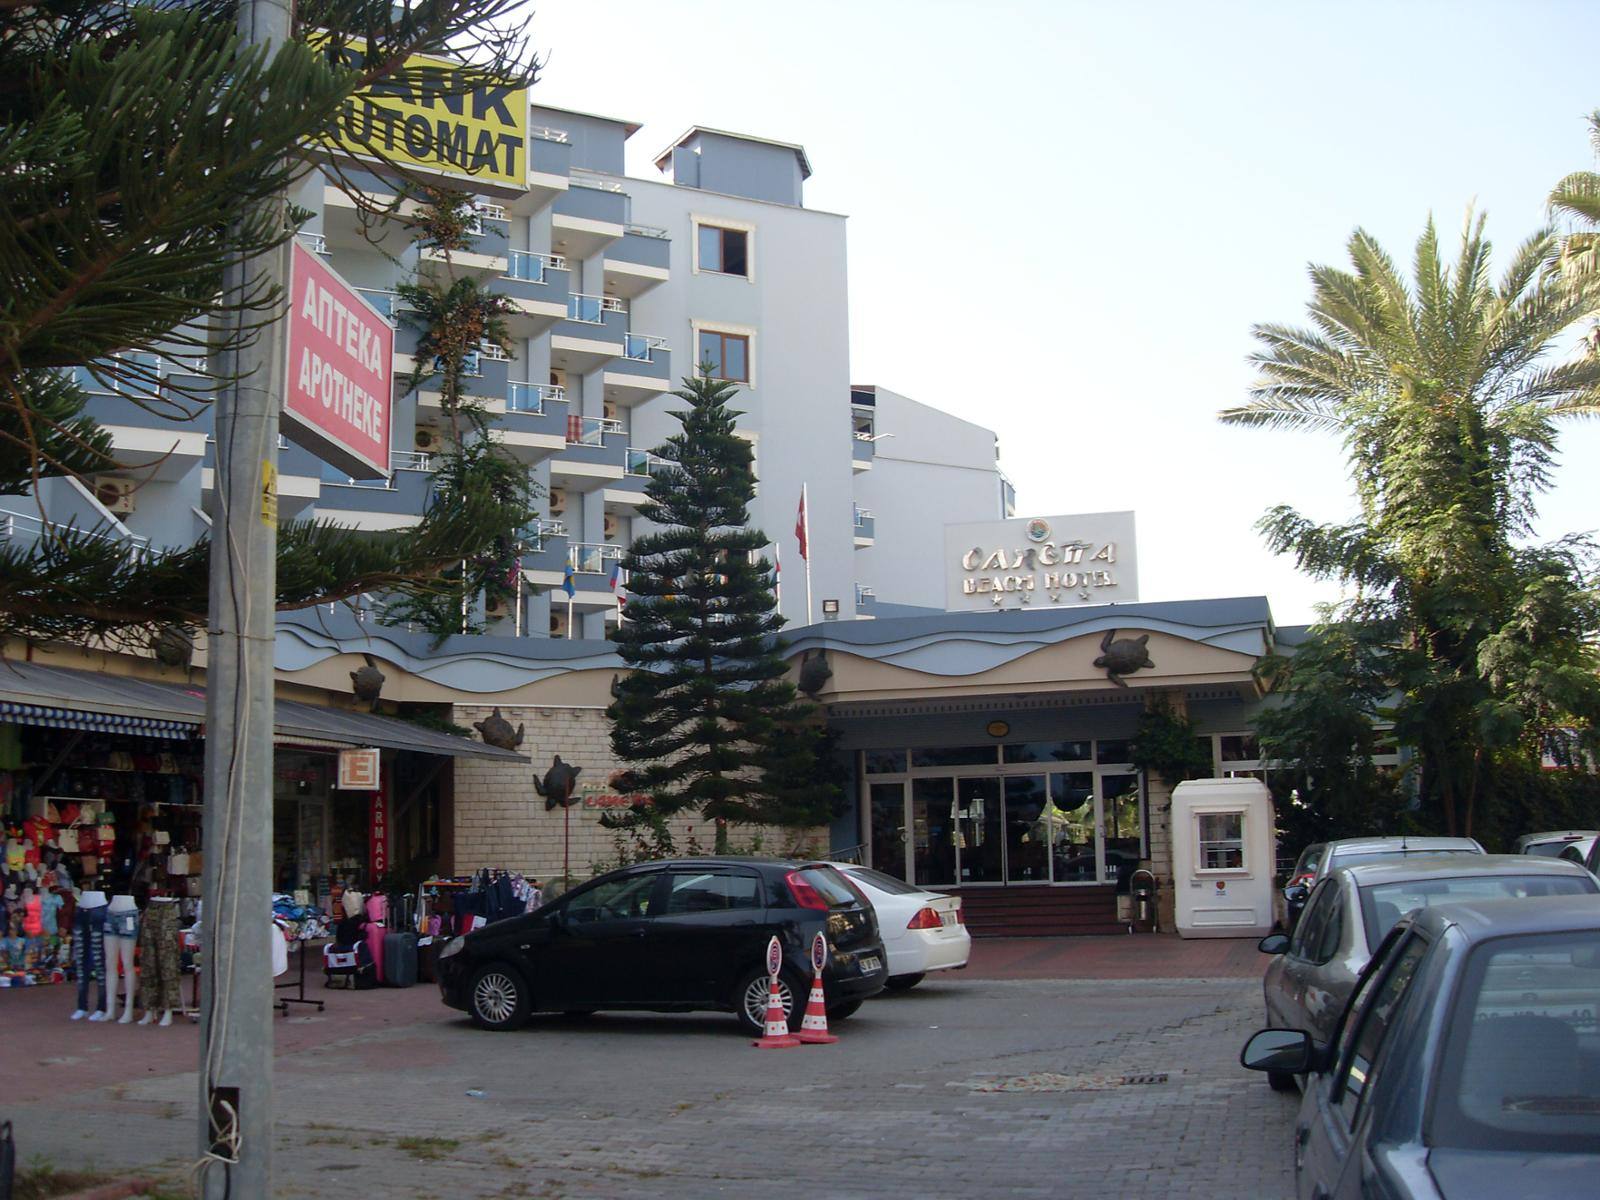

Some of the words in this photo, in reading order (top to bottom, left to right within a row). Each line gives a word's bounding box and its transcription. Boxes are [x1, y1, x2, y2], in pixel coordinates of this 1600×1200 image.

[302, 277, 383, 381] АПТЕКА
[298, 347, 382, 444] APOTHEKE
[963, 574, 1035, 594] BEACH
[1044, 570, 1117, 589] HOTEL
